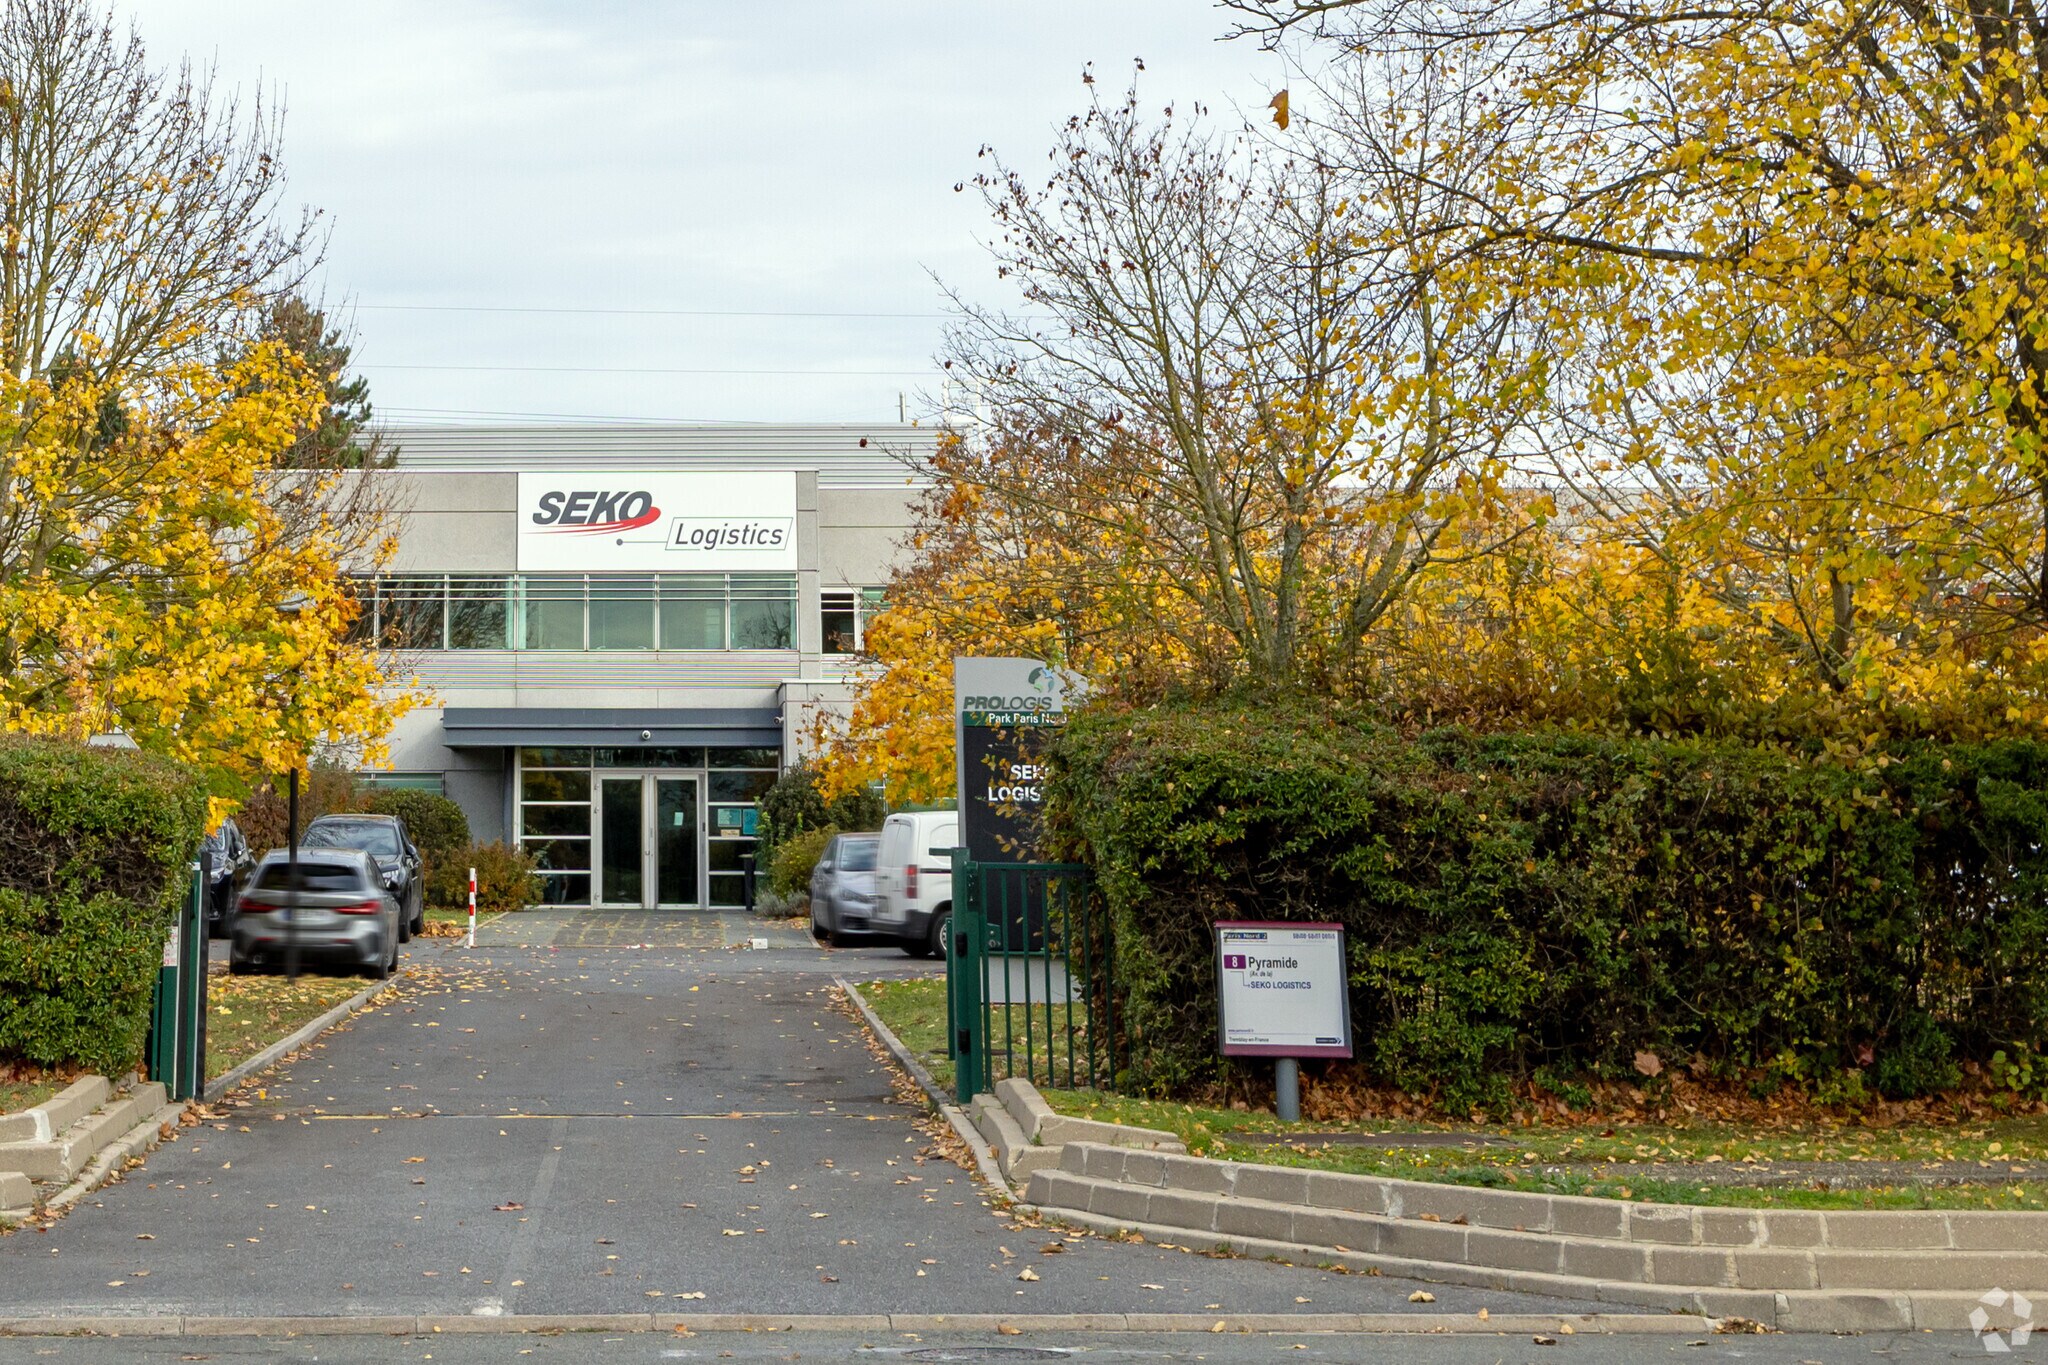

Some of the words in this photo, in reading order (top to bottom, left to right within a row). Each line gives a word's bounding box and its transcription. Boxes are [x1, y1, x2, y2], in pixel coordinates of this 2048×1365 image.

[532, 490, 653, 524] SEKO
[675, 523, 783, 550] Logistics
[963, 696, 1053, 710] PROLOGIS
[988, 713, 1011, 723] Park
[1013, 713, 1039, 724] Paris
[1010, 764, 1049, 780] SEK
[988, 786, 1045, 801] LOGIS
[1232, 956, 1238, 968] 8
[1248, 957, 1298, 971] Pyramide
[1250, 981, 1271, 989] SEKO
[1273, 981, 1312, 989] LOGISTICS
